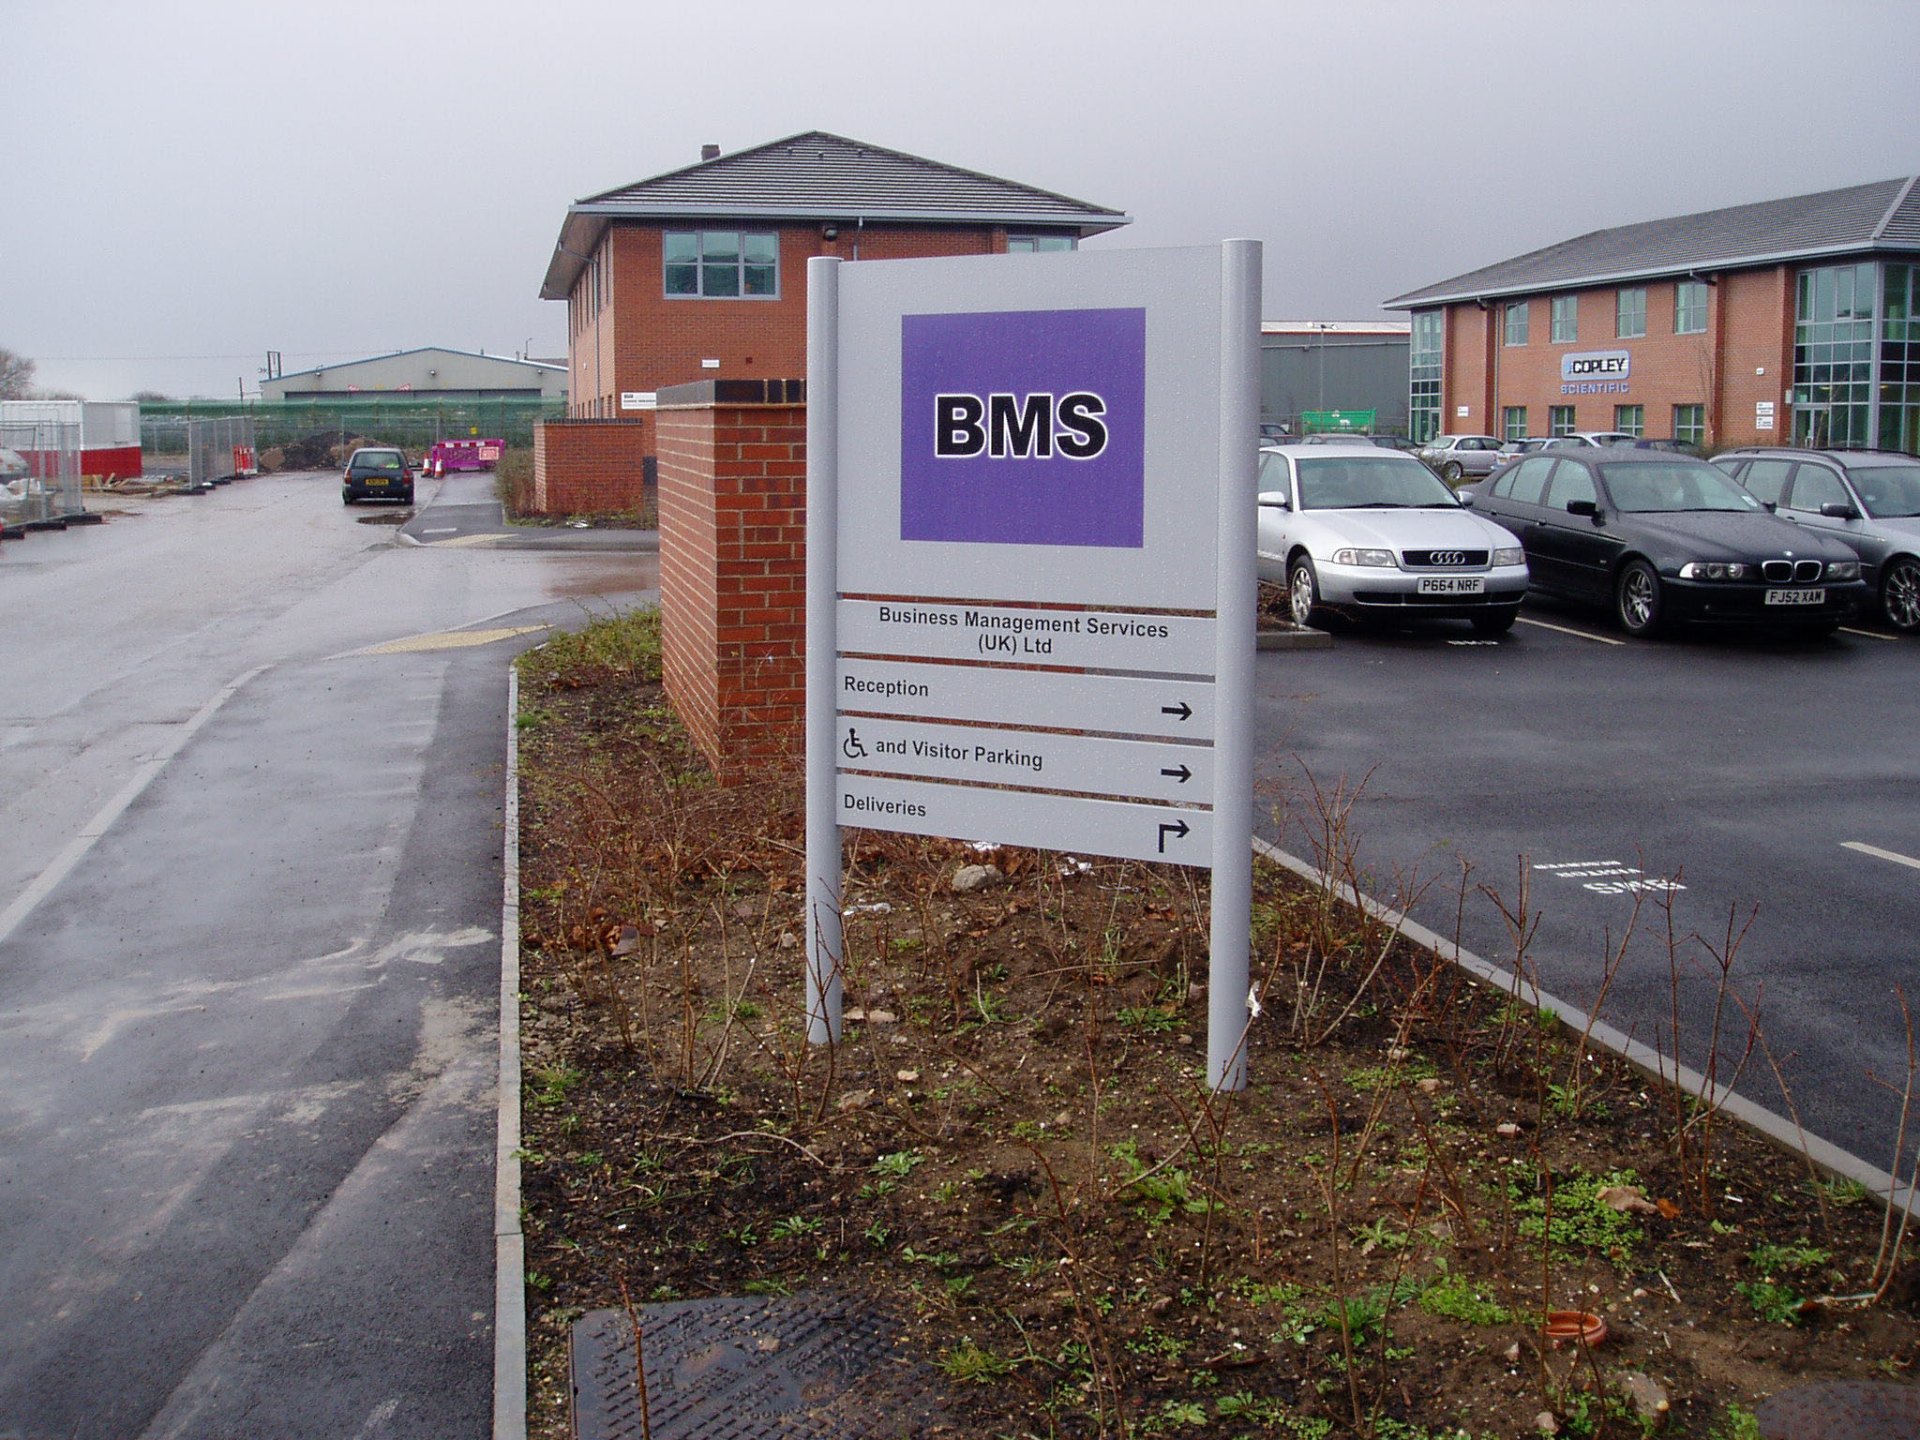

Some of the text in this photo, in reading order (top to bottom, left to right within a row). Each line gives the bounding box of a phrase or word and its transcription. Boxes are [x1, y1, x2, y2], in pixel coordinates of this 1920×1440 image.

[1572, 358, 1626, 374] COPLEY
[1560, 382, 1630, 395] SCIENTIFIC
[935, 391, 1109, 460] BMS
[1422, 580, 1480, 592] P664 NRF
[1769, 591, 1800, 603] FJ52
[879, 606, 1169, 638] Business Management Services
[978, 634, 1053, 656] (UK) Ltd
[844, 676, 929, 698] Reception
[875, 739, 1043, 772] and Visitor Parking
[844, 794, 927, 818] Deliveries
